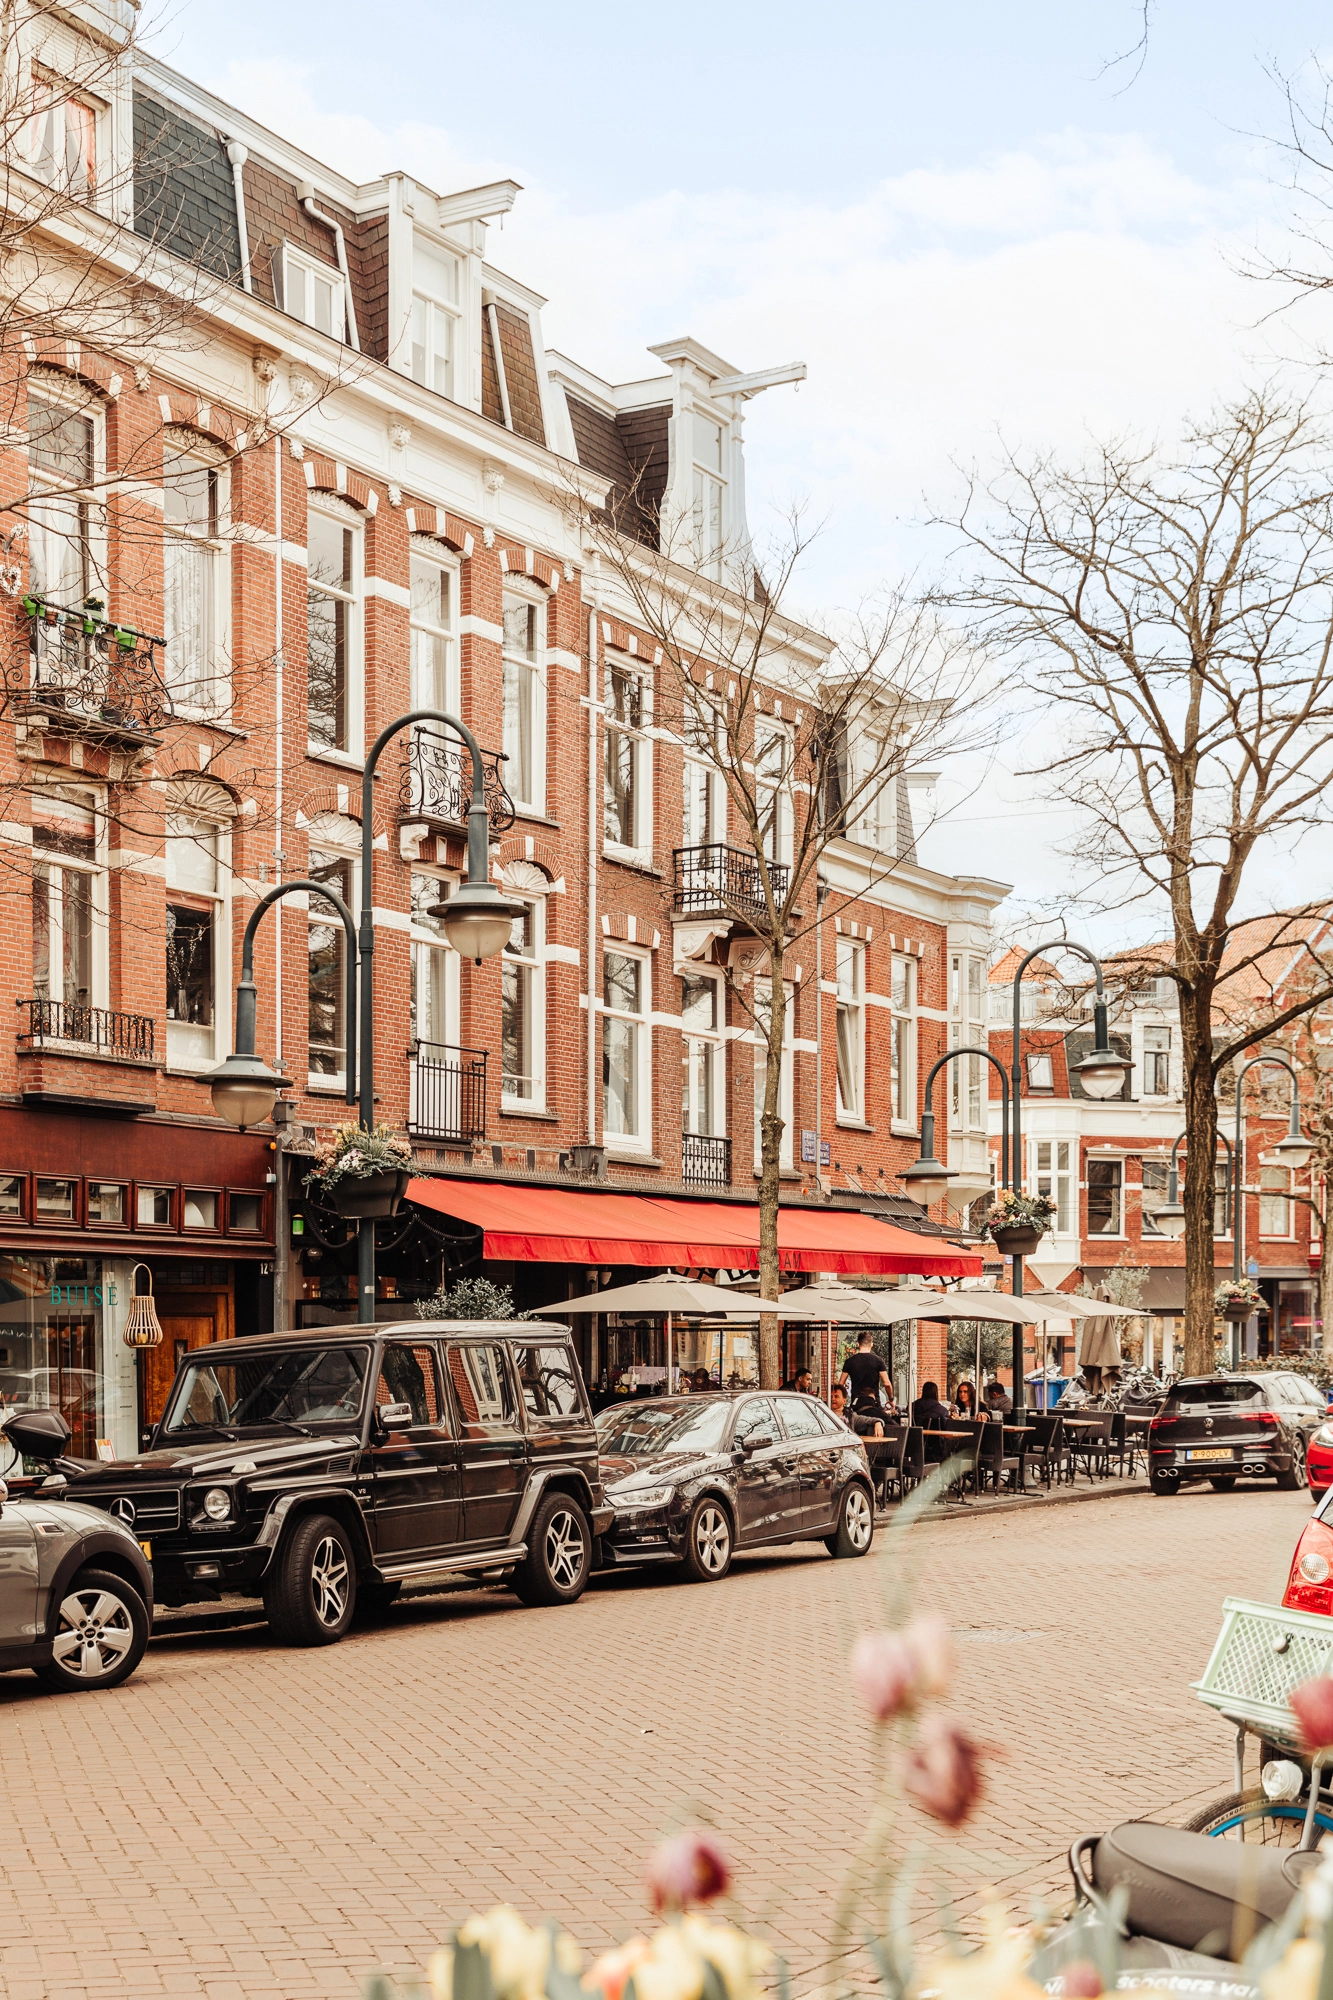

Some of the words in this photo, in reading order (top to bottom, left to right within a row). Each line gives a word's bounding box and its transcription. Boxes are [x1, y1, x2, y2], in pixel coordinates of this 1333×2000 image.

[778, 1252, 801, 1269] AM
[50, 1285, 119, 1306] BUISE
[1115, 1975, 1216, 1992] scooters
